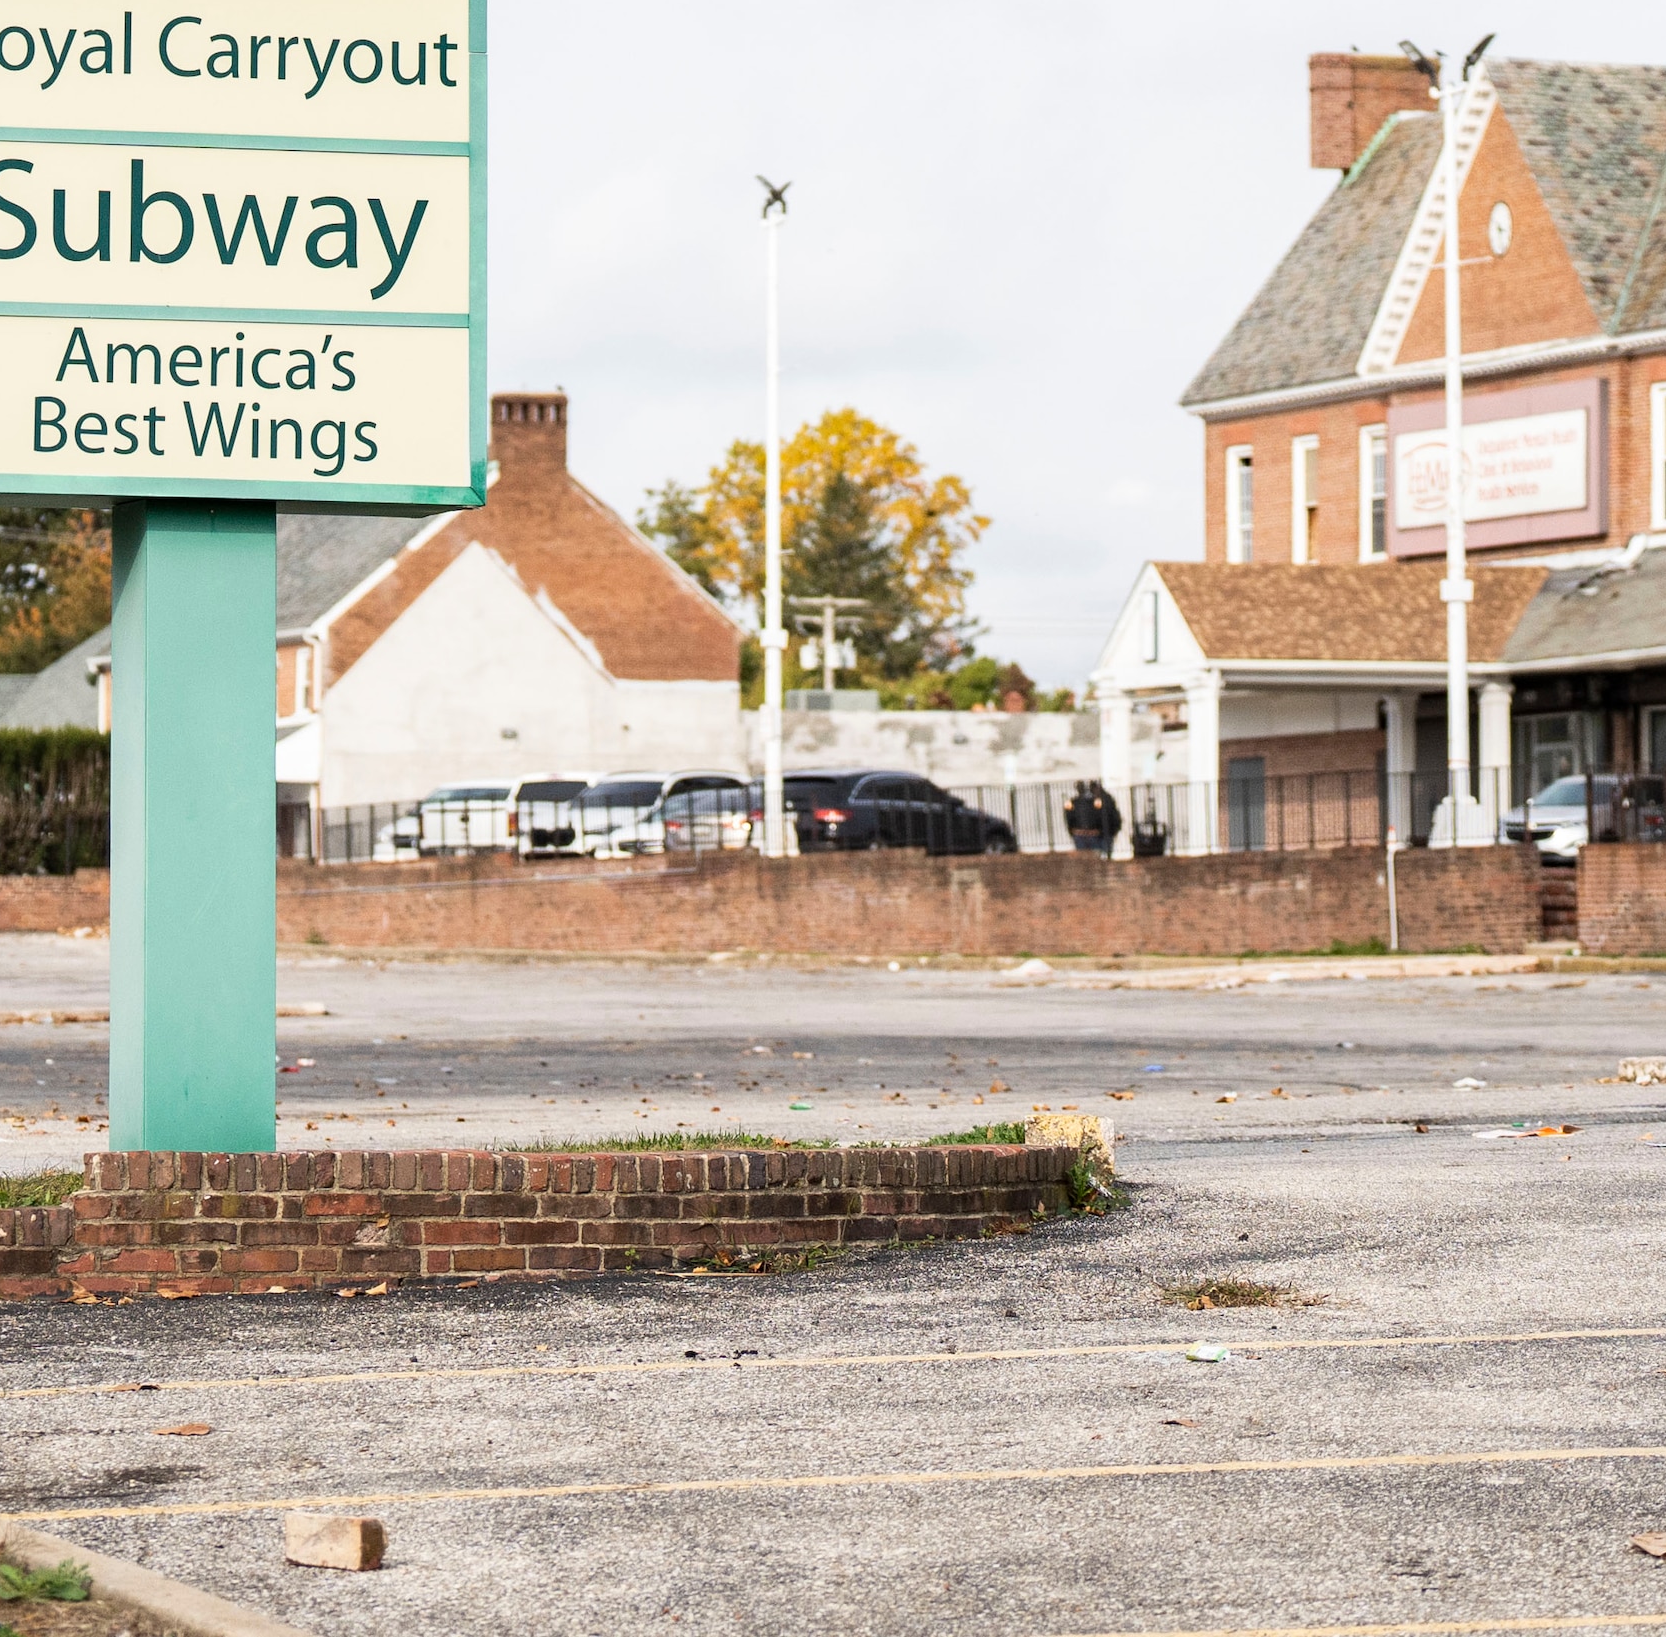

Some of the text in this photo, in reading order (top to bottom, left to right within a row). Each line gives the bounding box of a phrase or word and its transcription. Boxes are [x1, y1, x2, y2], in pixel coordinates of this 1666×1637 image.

[159, 16, 457, 96] Carryout
[56, 327, 355, 391] America's
[34, 396, 377, 476] Best Wings
